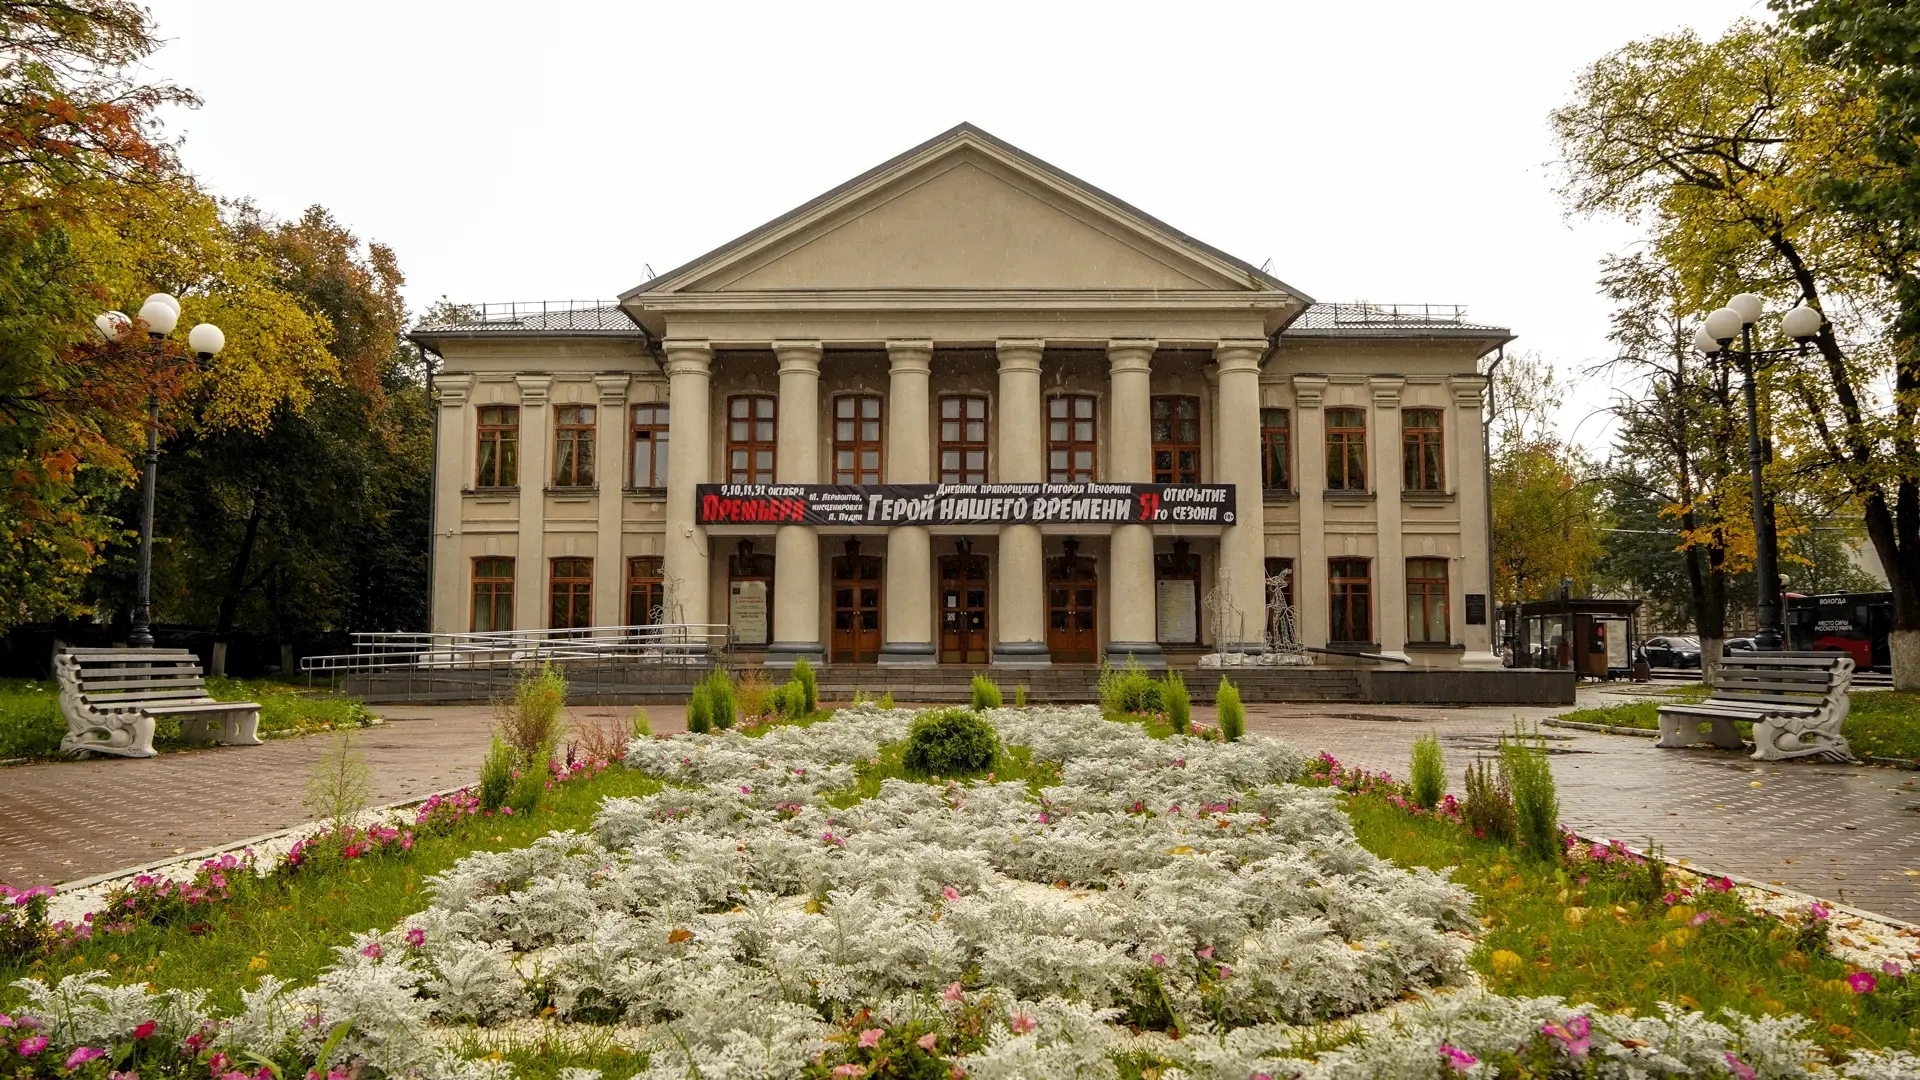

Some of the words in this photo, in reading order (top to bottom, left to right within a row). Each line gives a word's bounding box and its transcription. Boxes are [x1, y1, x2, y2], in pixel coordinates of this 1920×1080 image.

[936, 484, 977, 496] ДНЕВНИК
[980, 484, 1039, 496] ПРАПОРЩИКА
[1042, 483, 1084, 494] ГРИГОРИЯ
[1087, 483, 1132, 494] ПЕЧОРИНА
[1163, 487, 1226, 503] ОТКРЫТИЕ
[702, 494, 805, 521] ПРЕМЬЕРА
[867, 494, 935, 521] ГЕРОЙ
[939, 497, 1028, 520] НАШЕГО
[1032, 497, 1132, 520] ВРЕМЕНИ
[1173, 505, 1217, 521] СЕЗОНА
